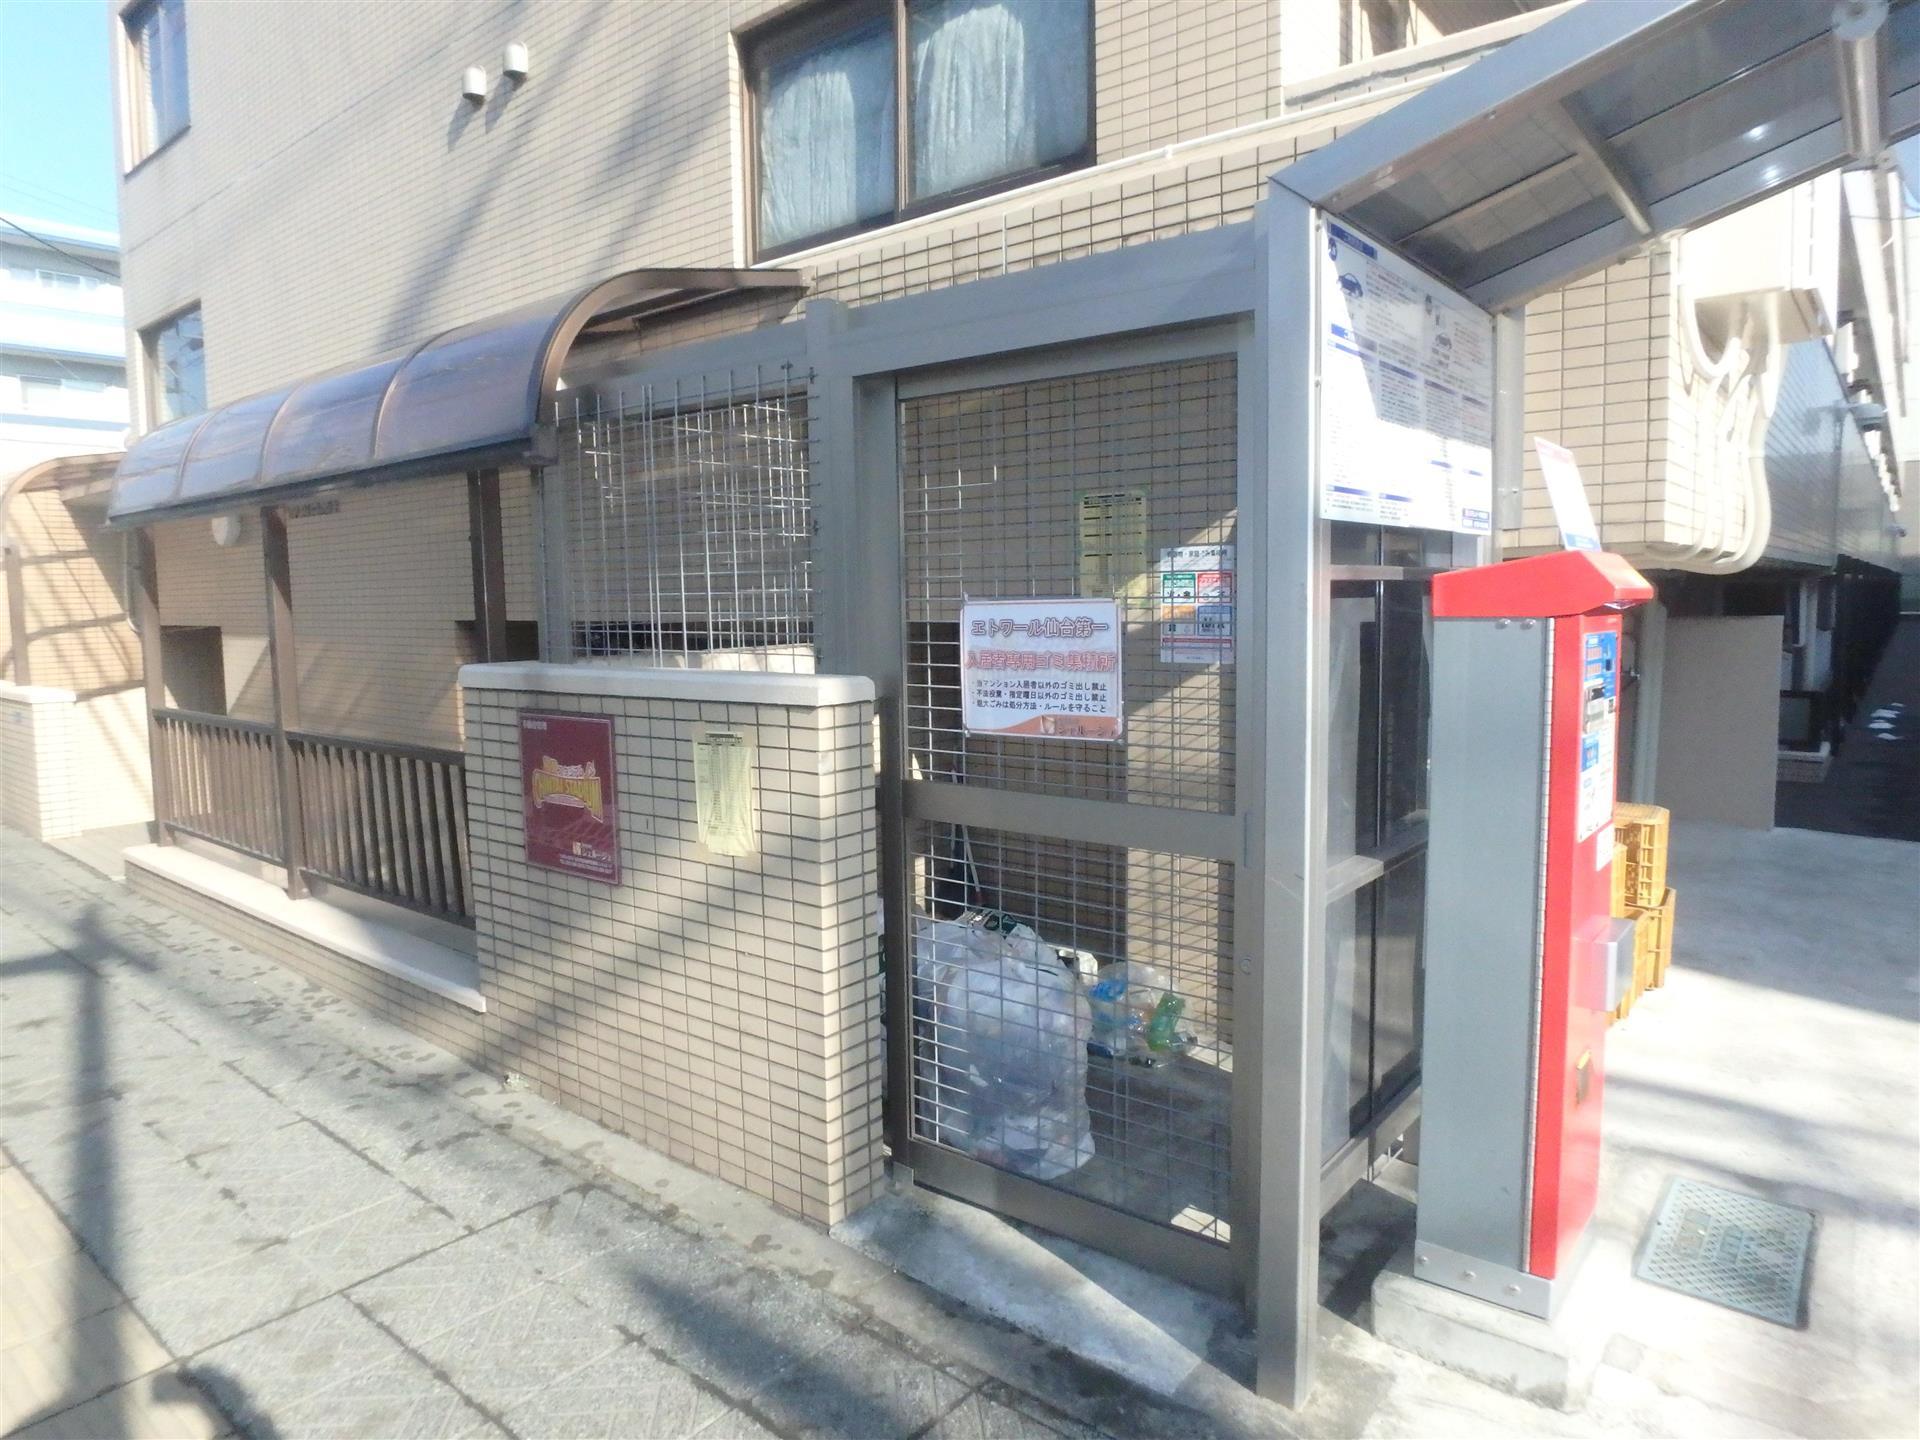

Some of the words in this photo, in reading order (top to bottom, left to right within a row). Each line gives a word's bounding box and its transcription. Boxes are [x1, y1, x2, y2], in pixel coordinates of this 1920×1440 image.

[971, 616, 1109, 638] エトワール仙台第一
